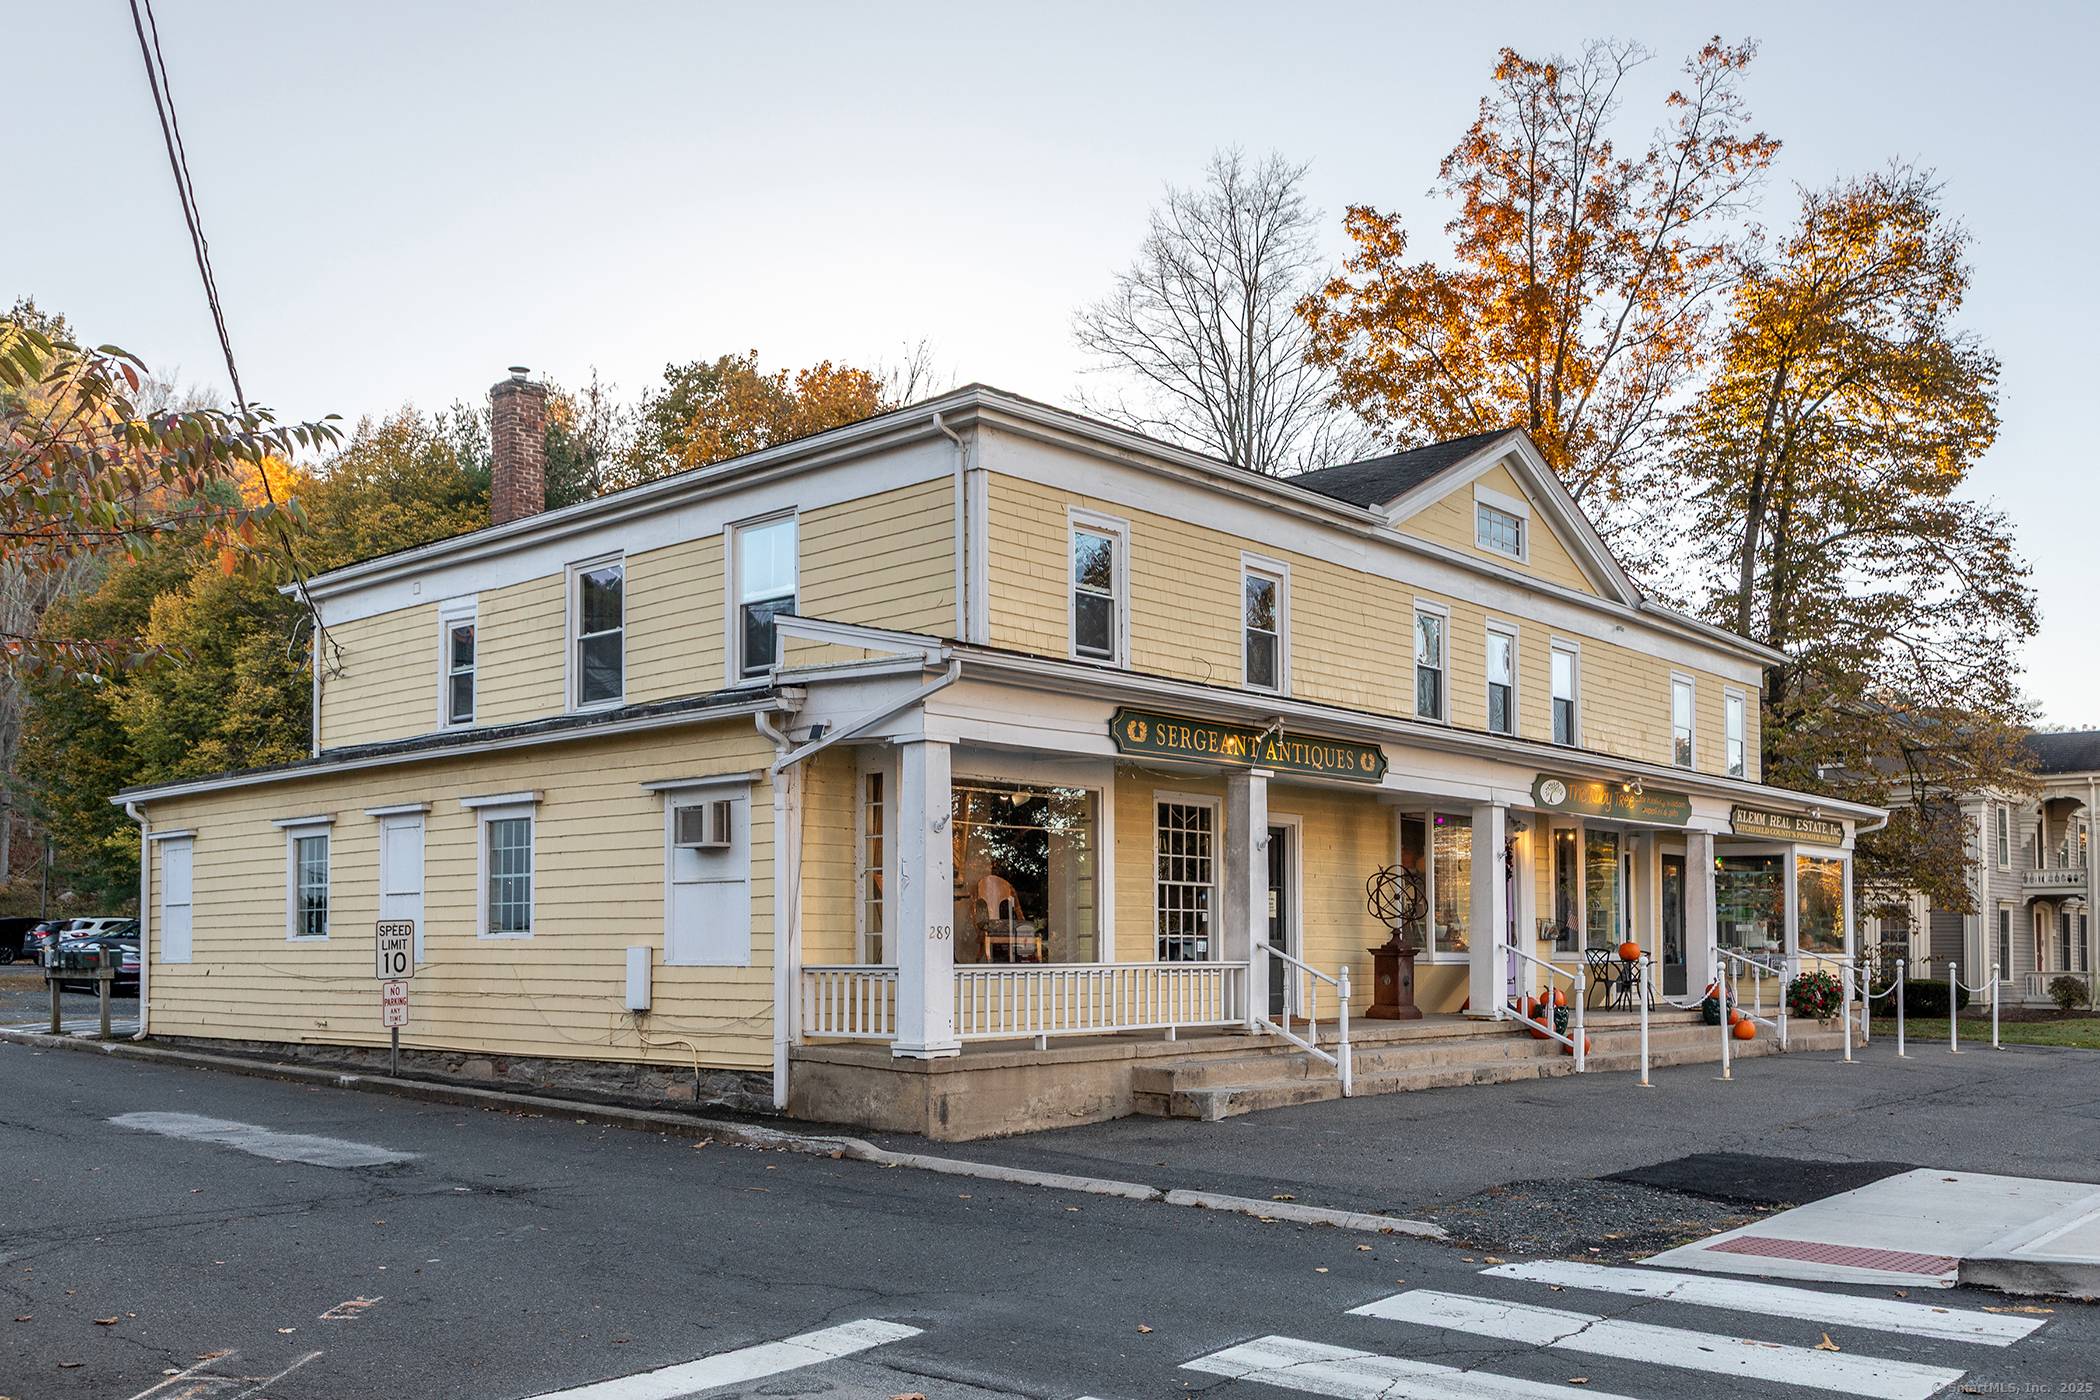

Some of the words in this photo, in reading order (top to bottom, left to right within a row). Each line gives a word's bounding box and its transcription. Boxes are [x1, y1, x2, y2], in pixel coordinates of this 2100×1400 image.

[1156, 723, 1260, 758] SERGEANT
[1266, 739, 1355, 770] ANTIQUES
[1736, 809, 1766, 826] KLEMM
[1769, 815, 1791, 830] REAL
[379, 925, 411, 936] SPEED
[928, 925, 951, 940] 289
[382, 939, 407, 950] LIMIT
[384, 952, 406, 973] 10
[390, 987, 400, 996] NO
[384, 996, 407, 1007] PARKING
